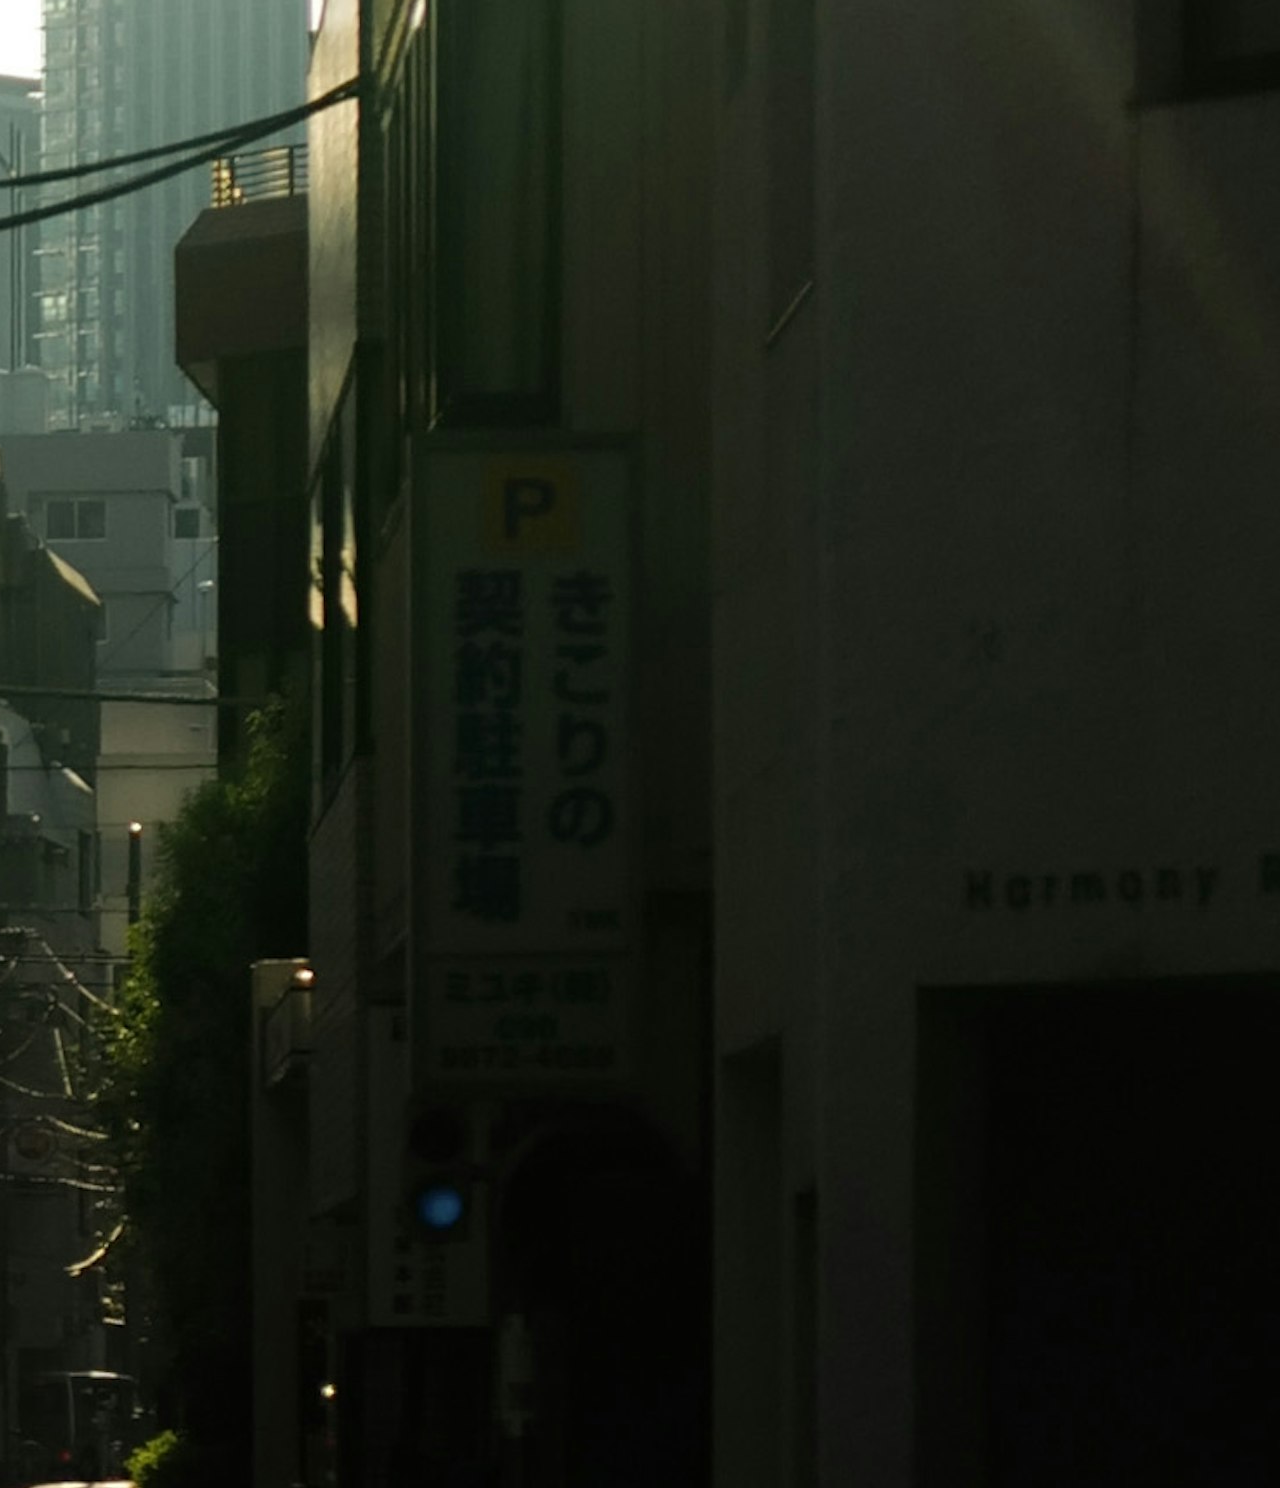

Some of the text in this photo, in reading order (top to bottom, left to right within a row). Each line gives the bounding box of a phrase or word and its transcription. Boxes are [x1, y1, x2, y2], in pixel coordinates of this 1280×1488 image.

[505, 478, 554, 540] P
[453, 568, 523, 923] 契約駐車場
[550, 570, 614, 850] きこりの
